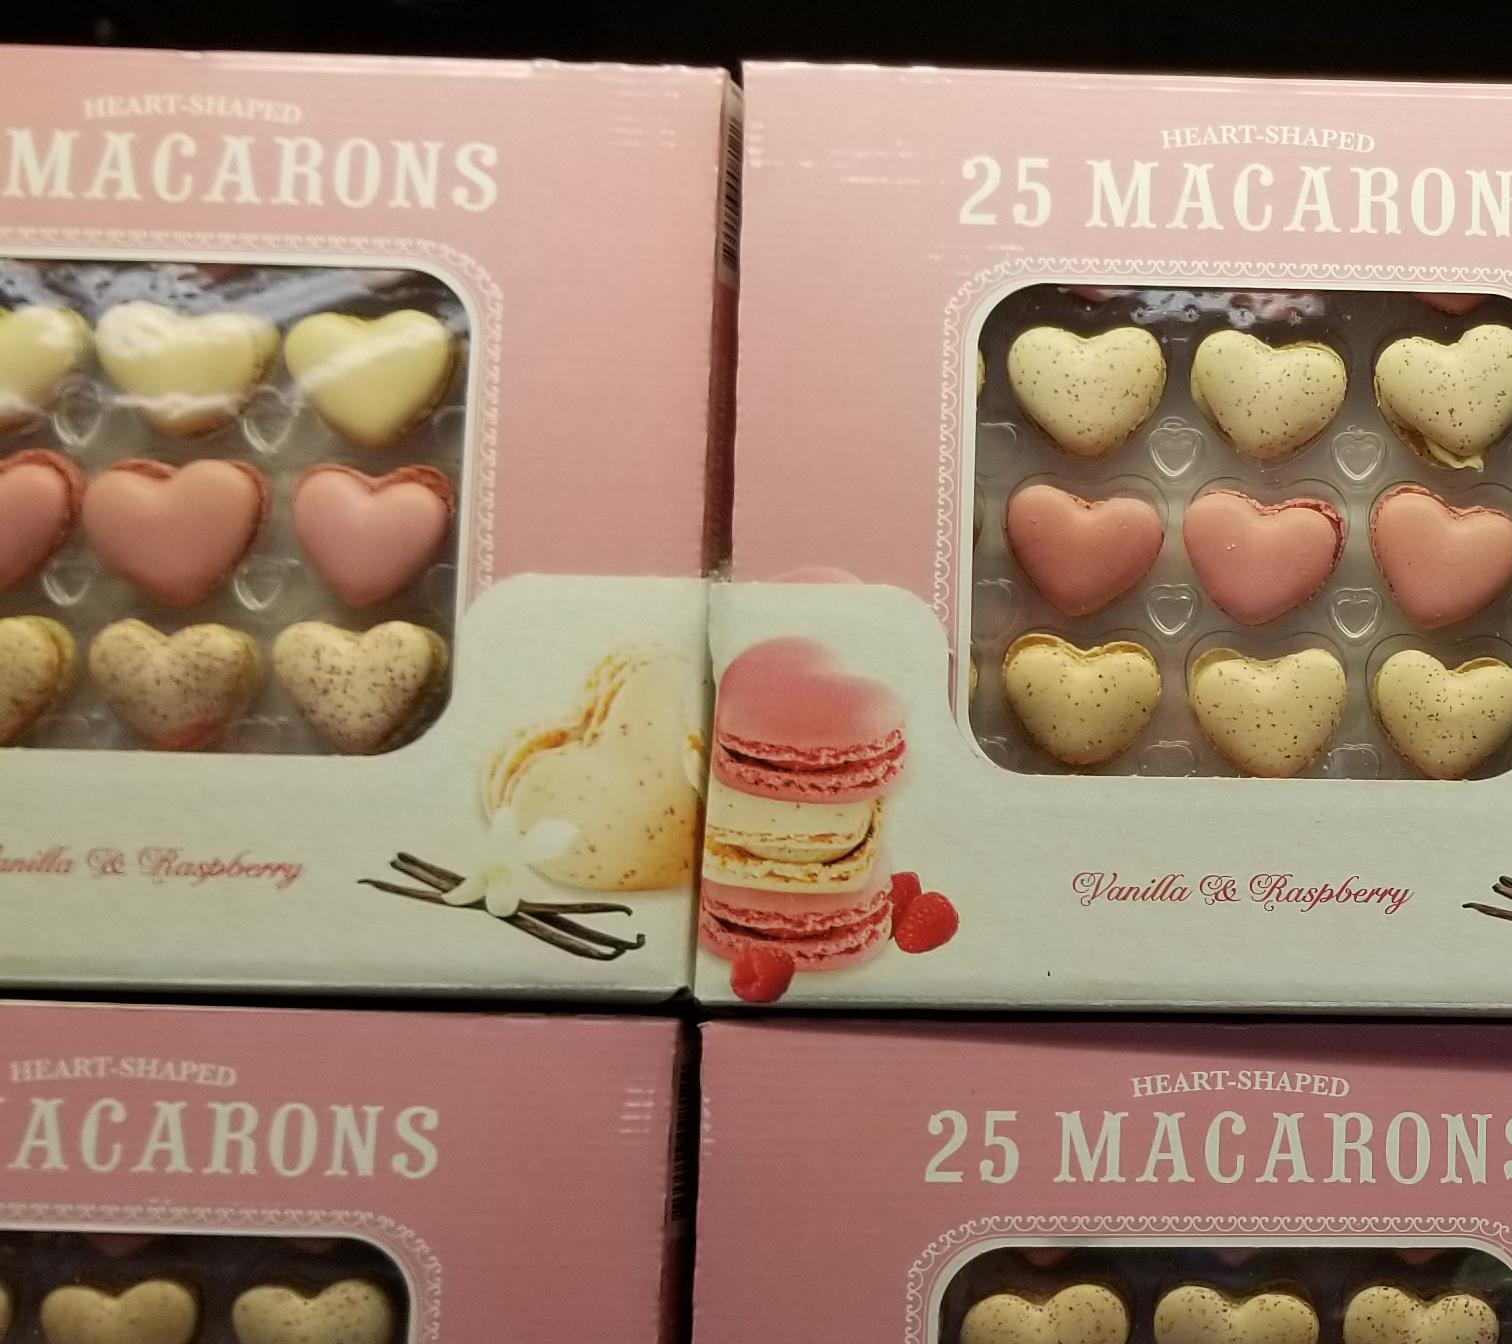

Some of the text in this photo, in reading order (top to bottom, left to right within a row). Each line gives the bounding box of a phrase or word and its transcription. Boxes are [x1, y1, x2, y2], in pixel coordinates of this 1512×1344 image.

[83, 93, 304, 126] HEART-SHAPED
[1160, 125, 1376, 154] HEART-SHAPED
[1, 127, 500, 213] MACARONS
[959, 155, 1052, 228] 25
[0, 843, 73, 874] anilla
[138, 846, 303, 891] Raspberry
[1072, 871, 1415, 915] Vanilla & Raspberry
[10, 1056, 238, 1088] HEART-SHAPED
[1130, 1070, 1351, 1099] HEART-SHAPED
[0, 1096, 440, 1180] ACARONS
[924, 1109, 1020, 1184] 25
